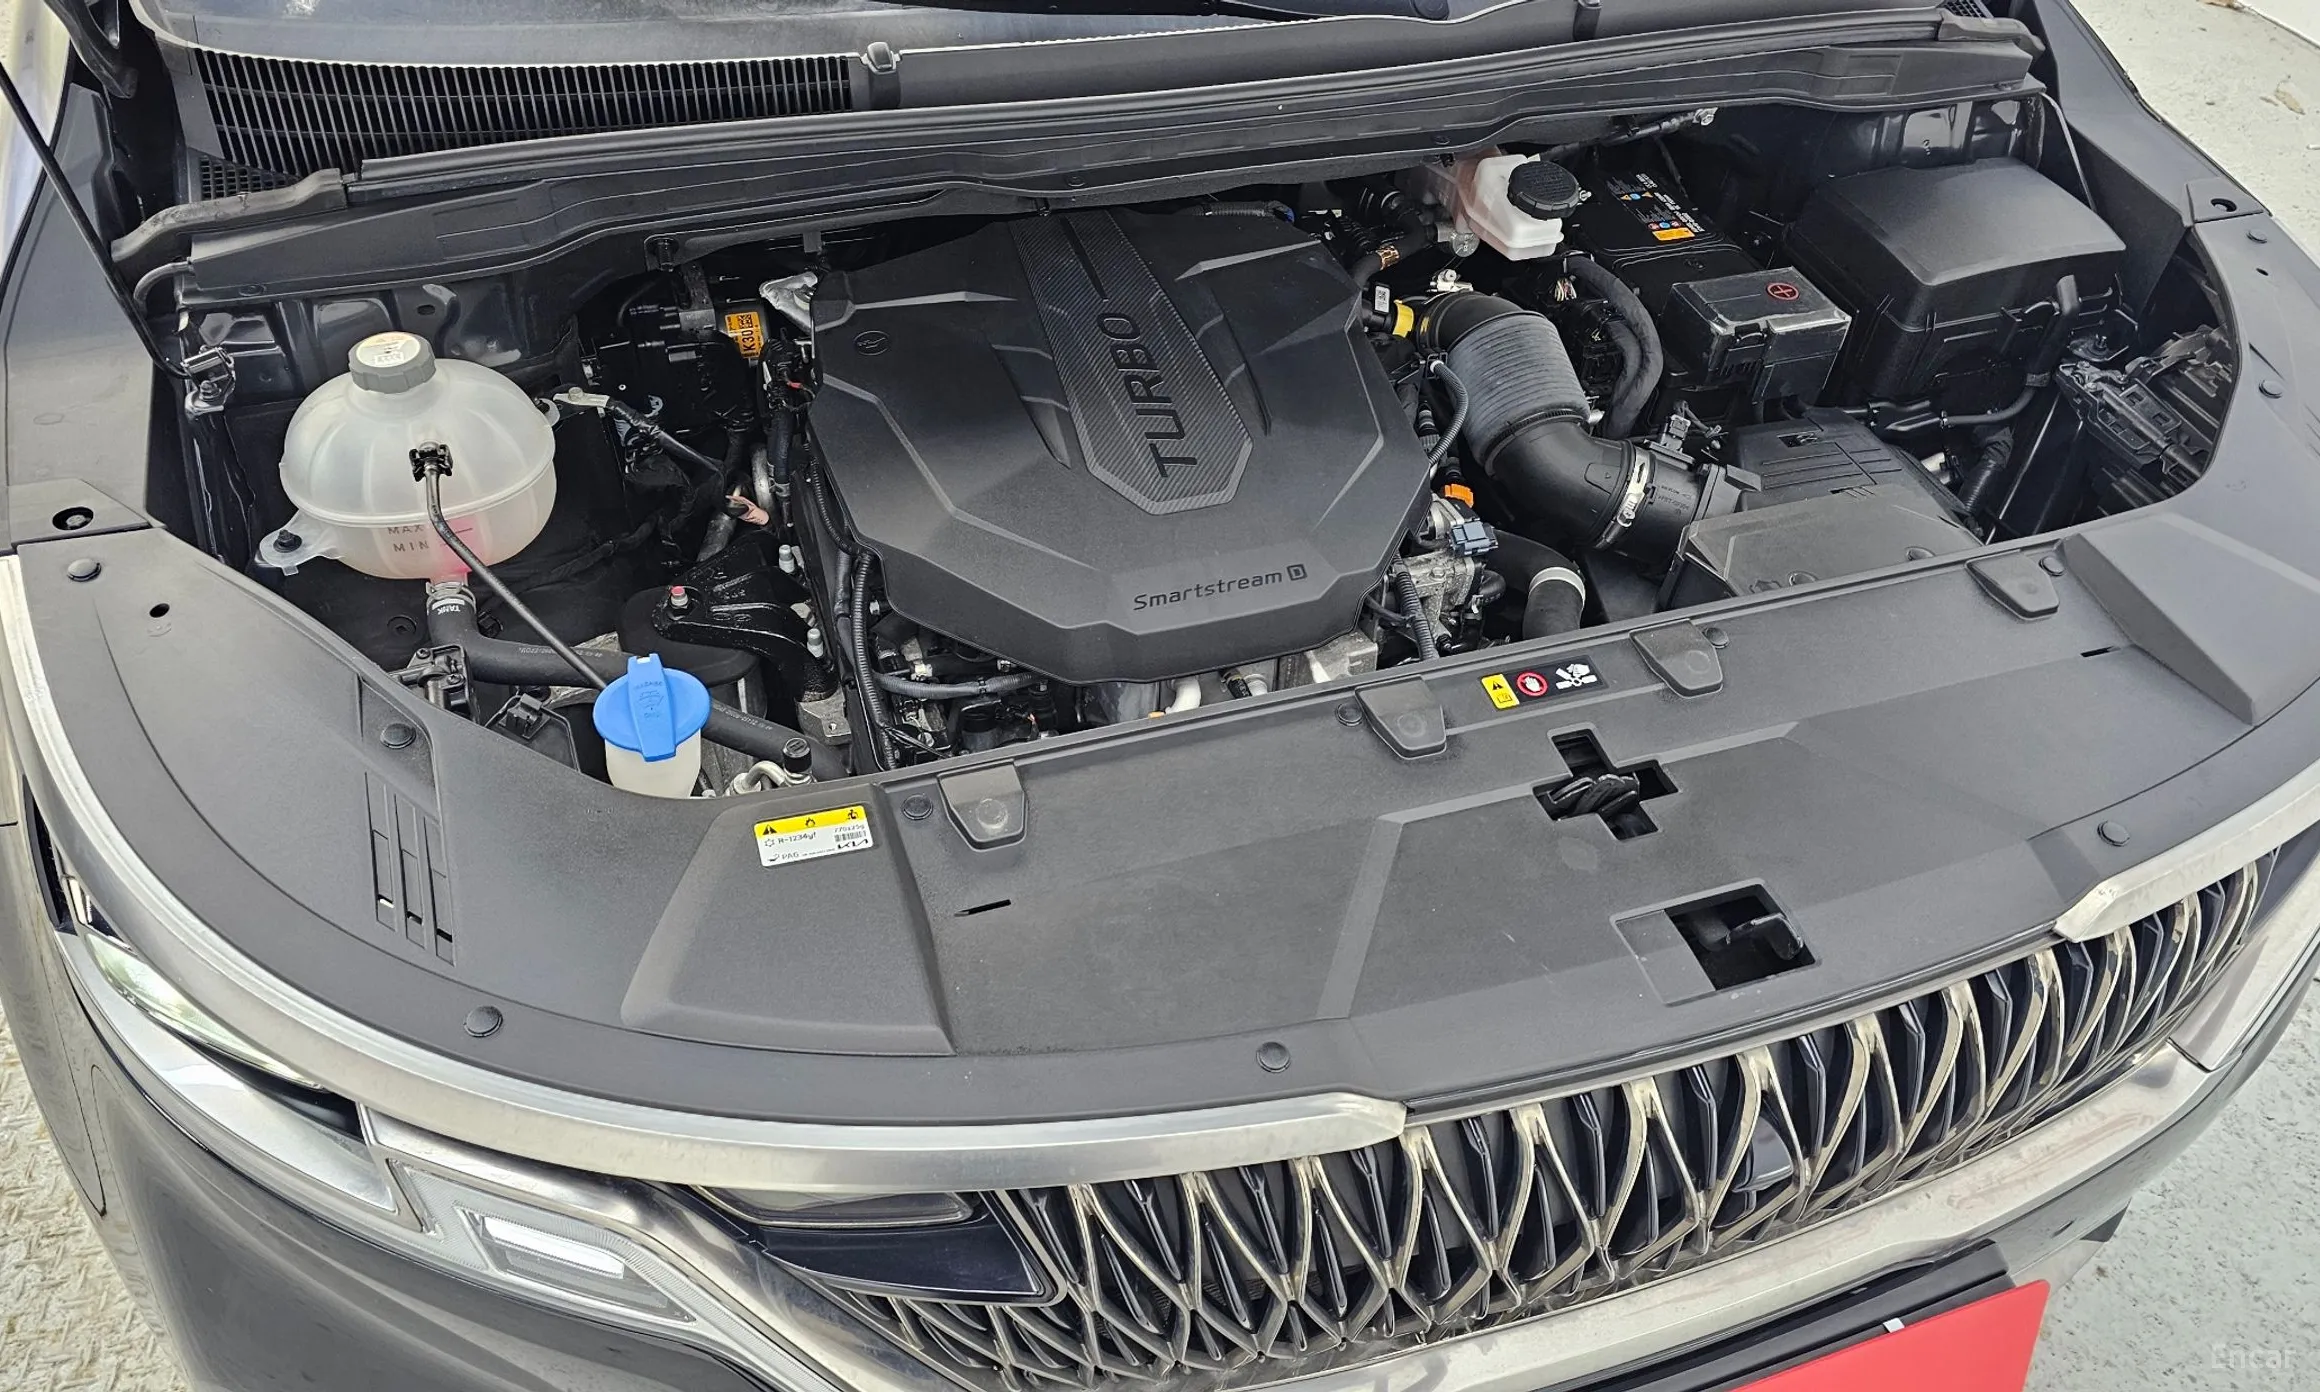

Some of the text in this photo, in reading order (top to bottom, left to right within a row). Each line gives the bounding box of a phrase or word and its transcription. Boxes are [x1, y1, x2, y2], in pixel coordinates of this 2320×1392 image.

[741, 330, 756, 351] K30
[1096, 312, 1198, 478] TURBO
[387, 524, 425, 535] MAX
[393, 540, 430, 552] MIN
[1132, 571, 1283, 611] Smartstream
[437, 604, 461, 615] TANK
[781, 852, 800, 861] PAG
